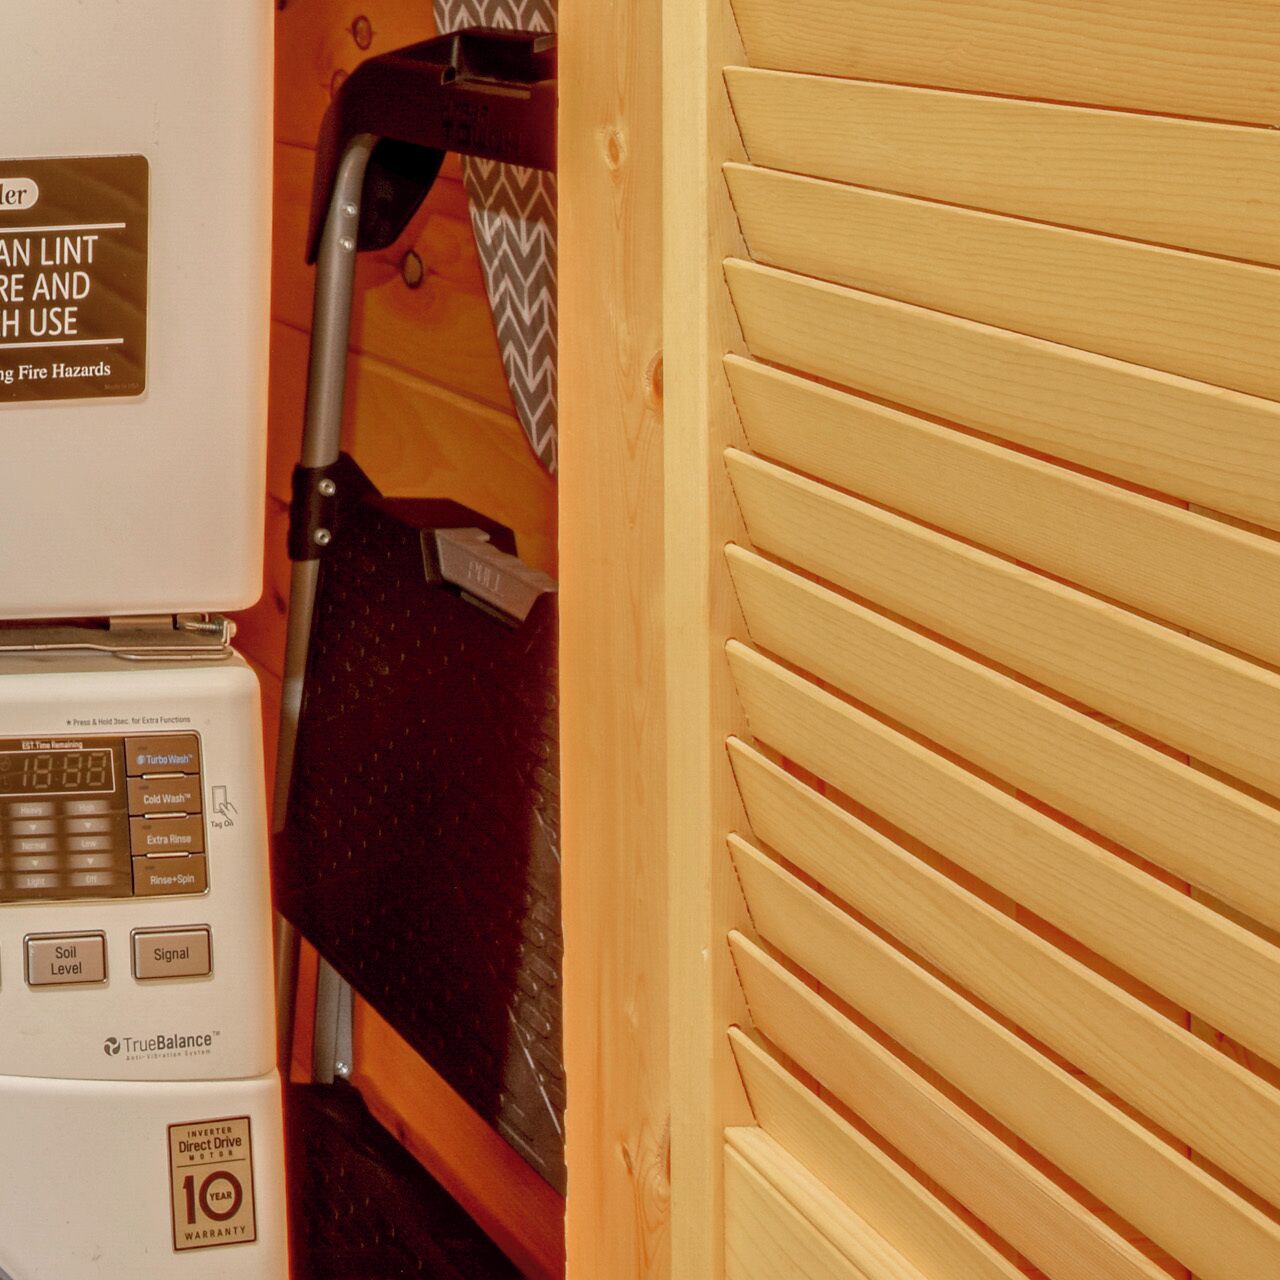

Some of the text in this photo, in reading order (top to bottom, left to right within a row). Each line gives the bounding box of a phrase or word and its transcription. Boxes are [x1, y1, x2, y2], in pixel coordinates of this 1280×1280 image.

[40, 235, 98, 265] LINT
[32, 271, 91, 301] AND
[29, 307, 79, 336] USE
[18, 364, 48, 381] Fire
[52, 361, 112, 379] Hazards
[142, 717, 159, 725] Extra
[159, 716, 191, 724] Functions
[143, 794, 161, 805] Cold
[211, 821, 223, 829] Tag
[146, 833, 192, 845] Extra Rinse
[150, 874, 195, 886] Rinse+Spin
[55, 945, 77, 960] Soil
[153, 946, 190, 963] Signal
[50, 961, 82, 976] Level
[187, 1126, 232, 1138] INVERTER
[178, 1136, 242, 1153] Direct Drive
[189, 1150, 233, 1161] MOTOR
[182, 1170, 243, 1225] 10
[209, 1191, 233, 1202] YEAR
[184, 1225, 247, 1241] WARRANTY
